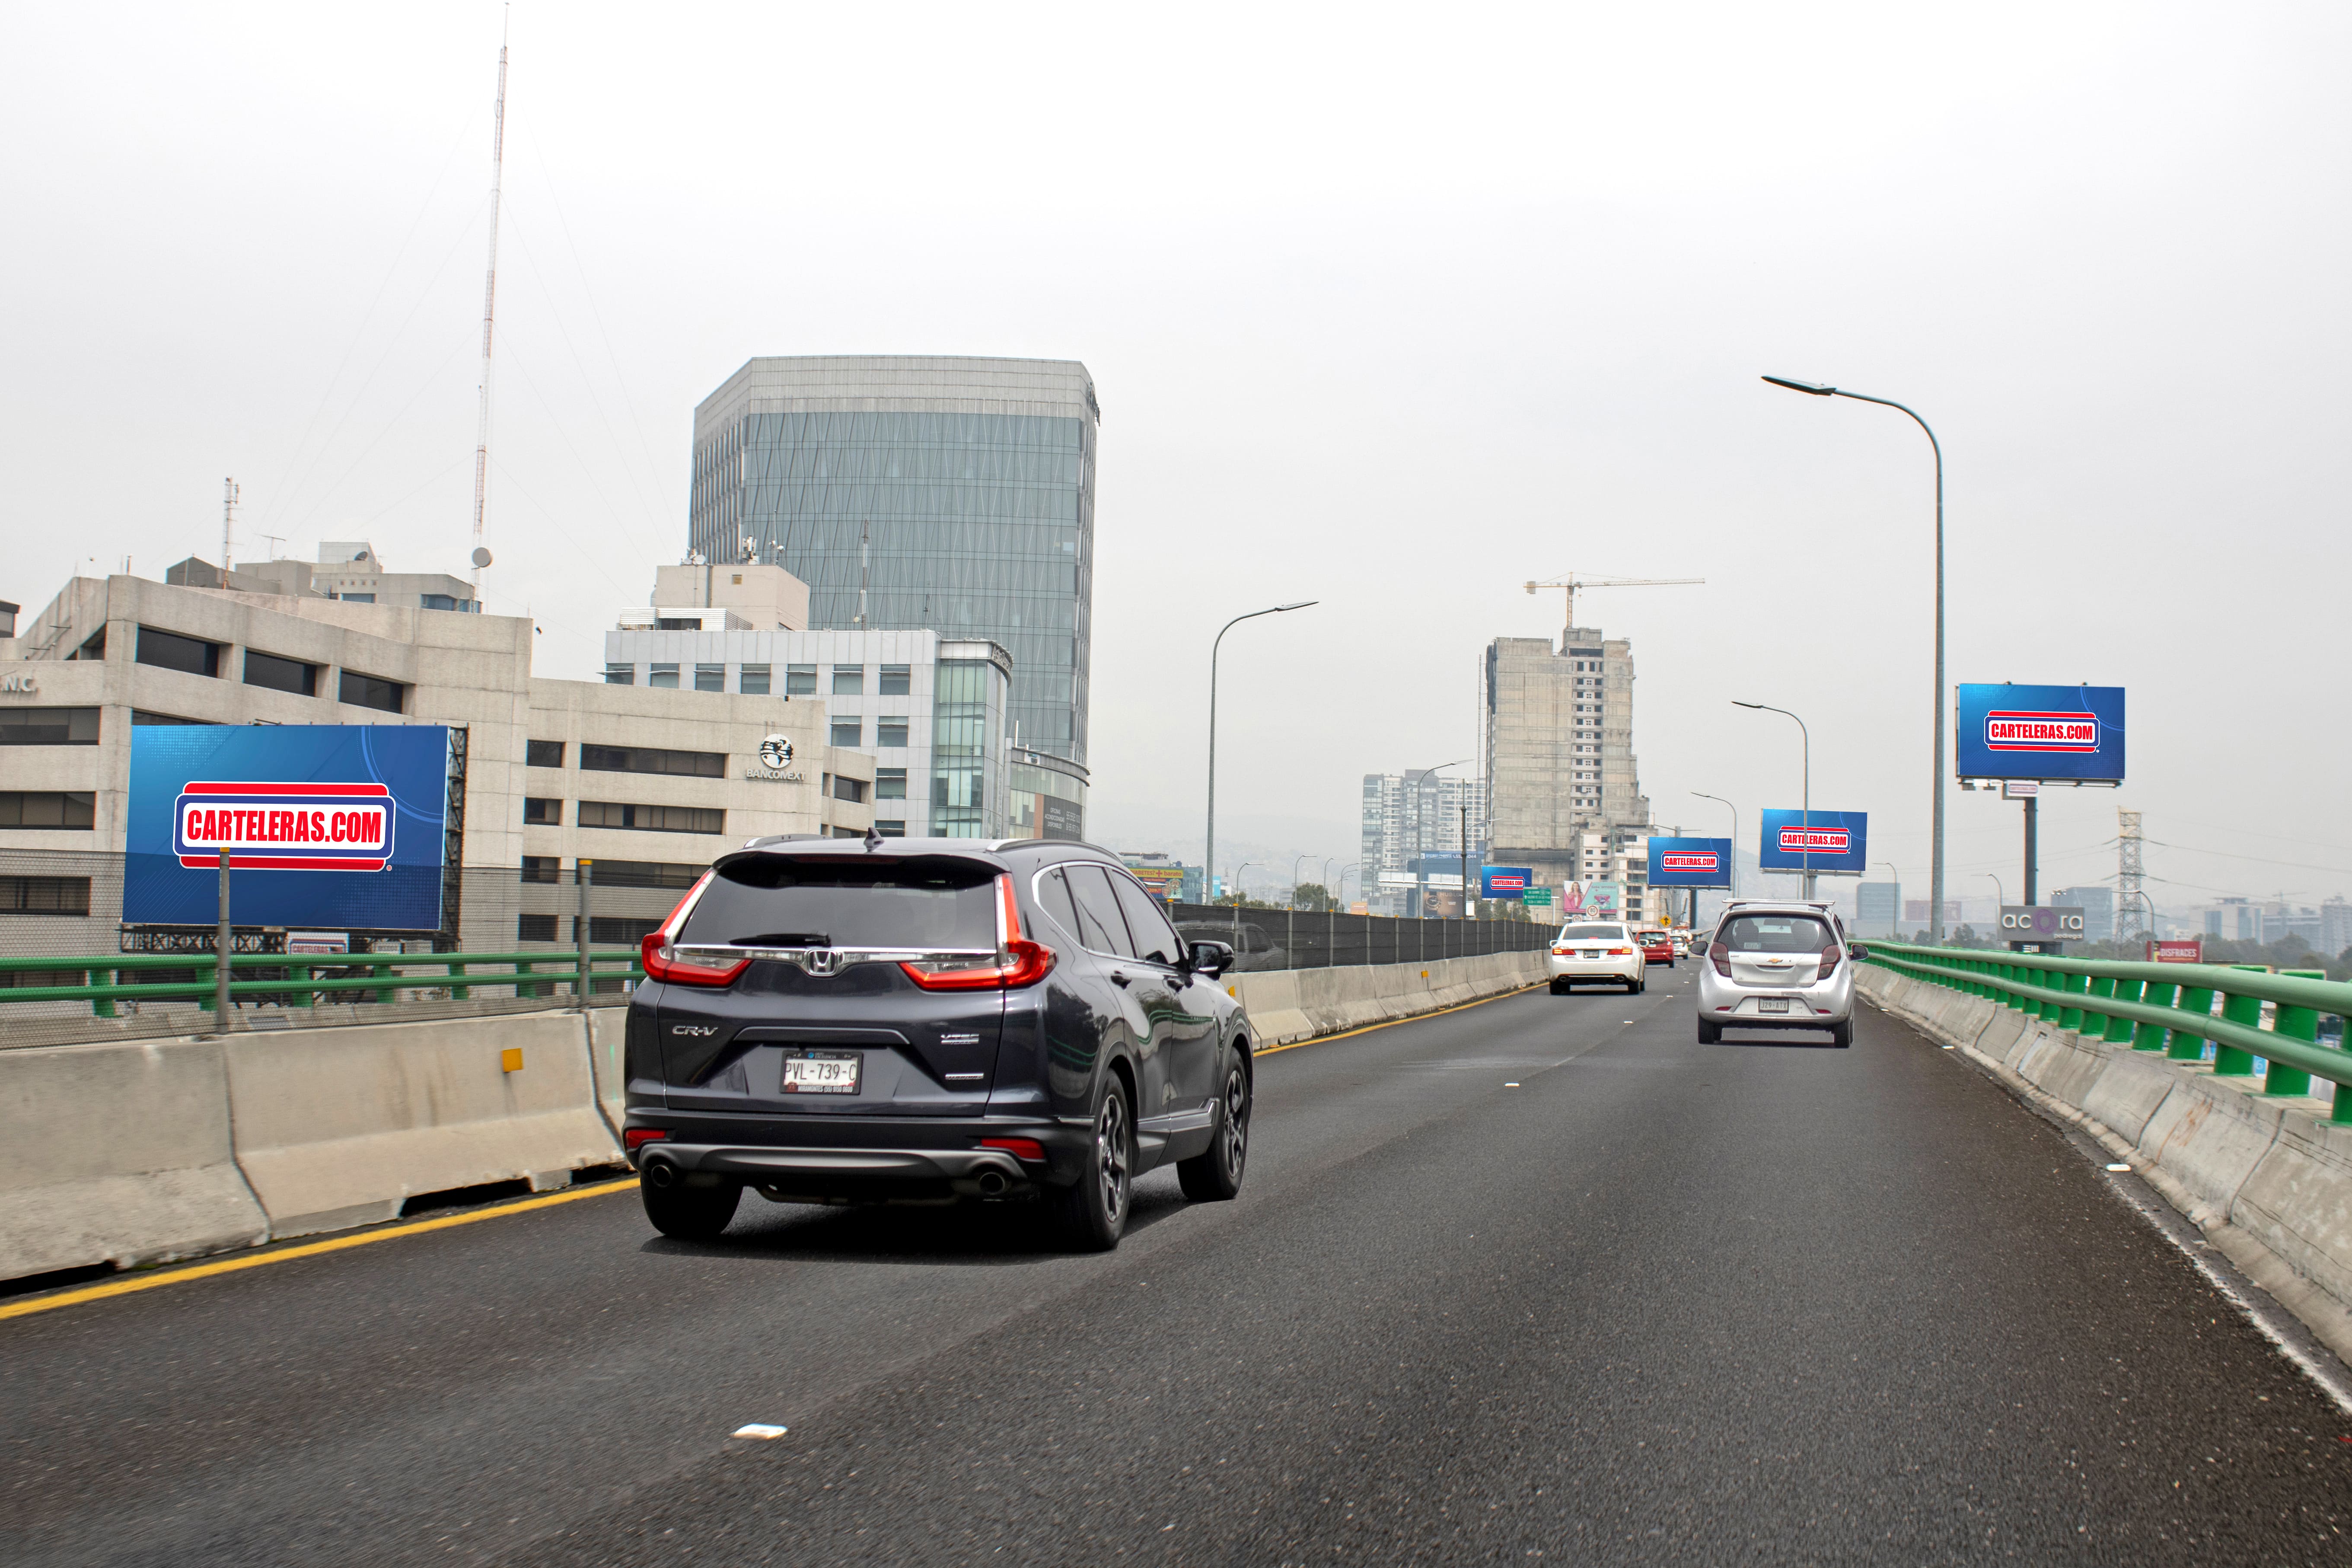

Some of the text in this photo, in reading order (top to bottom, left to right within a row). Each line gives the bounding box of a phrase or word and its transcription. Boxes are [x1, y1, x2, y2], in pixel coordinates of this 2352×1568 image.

[1992, 723, 2093, 740] CARTELERAS.COM
[746, 769, 806, 781] BANCOMEXT
[187, 810, 382, 843] CARTELERAS.COM
[1665, 857, 1715, 866] CARTELERAS.COM
[2160, 948, 2197, 957] DISFRACES
[672, 1026, 718, 1036] CR-V
